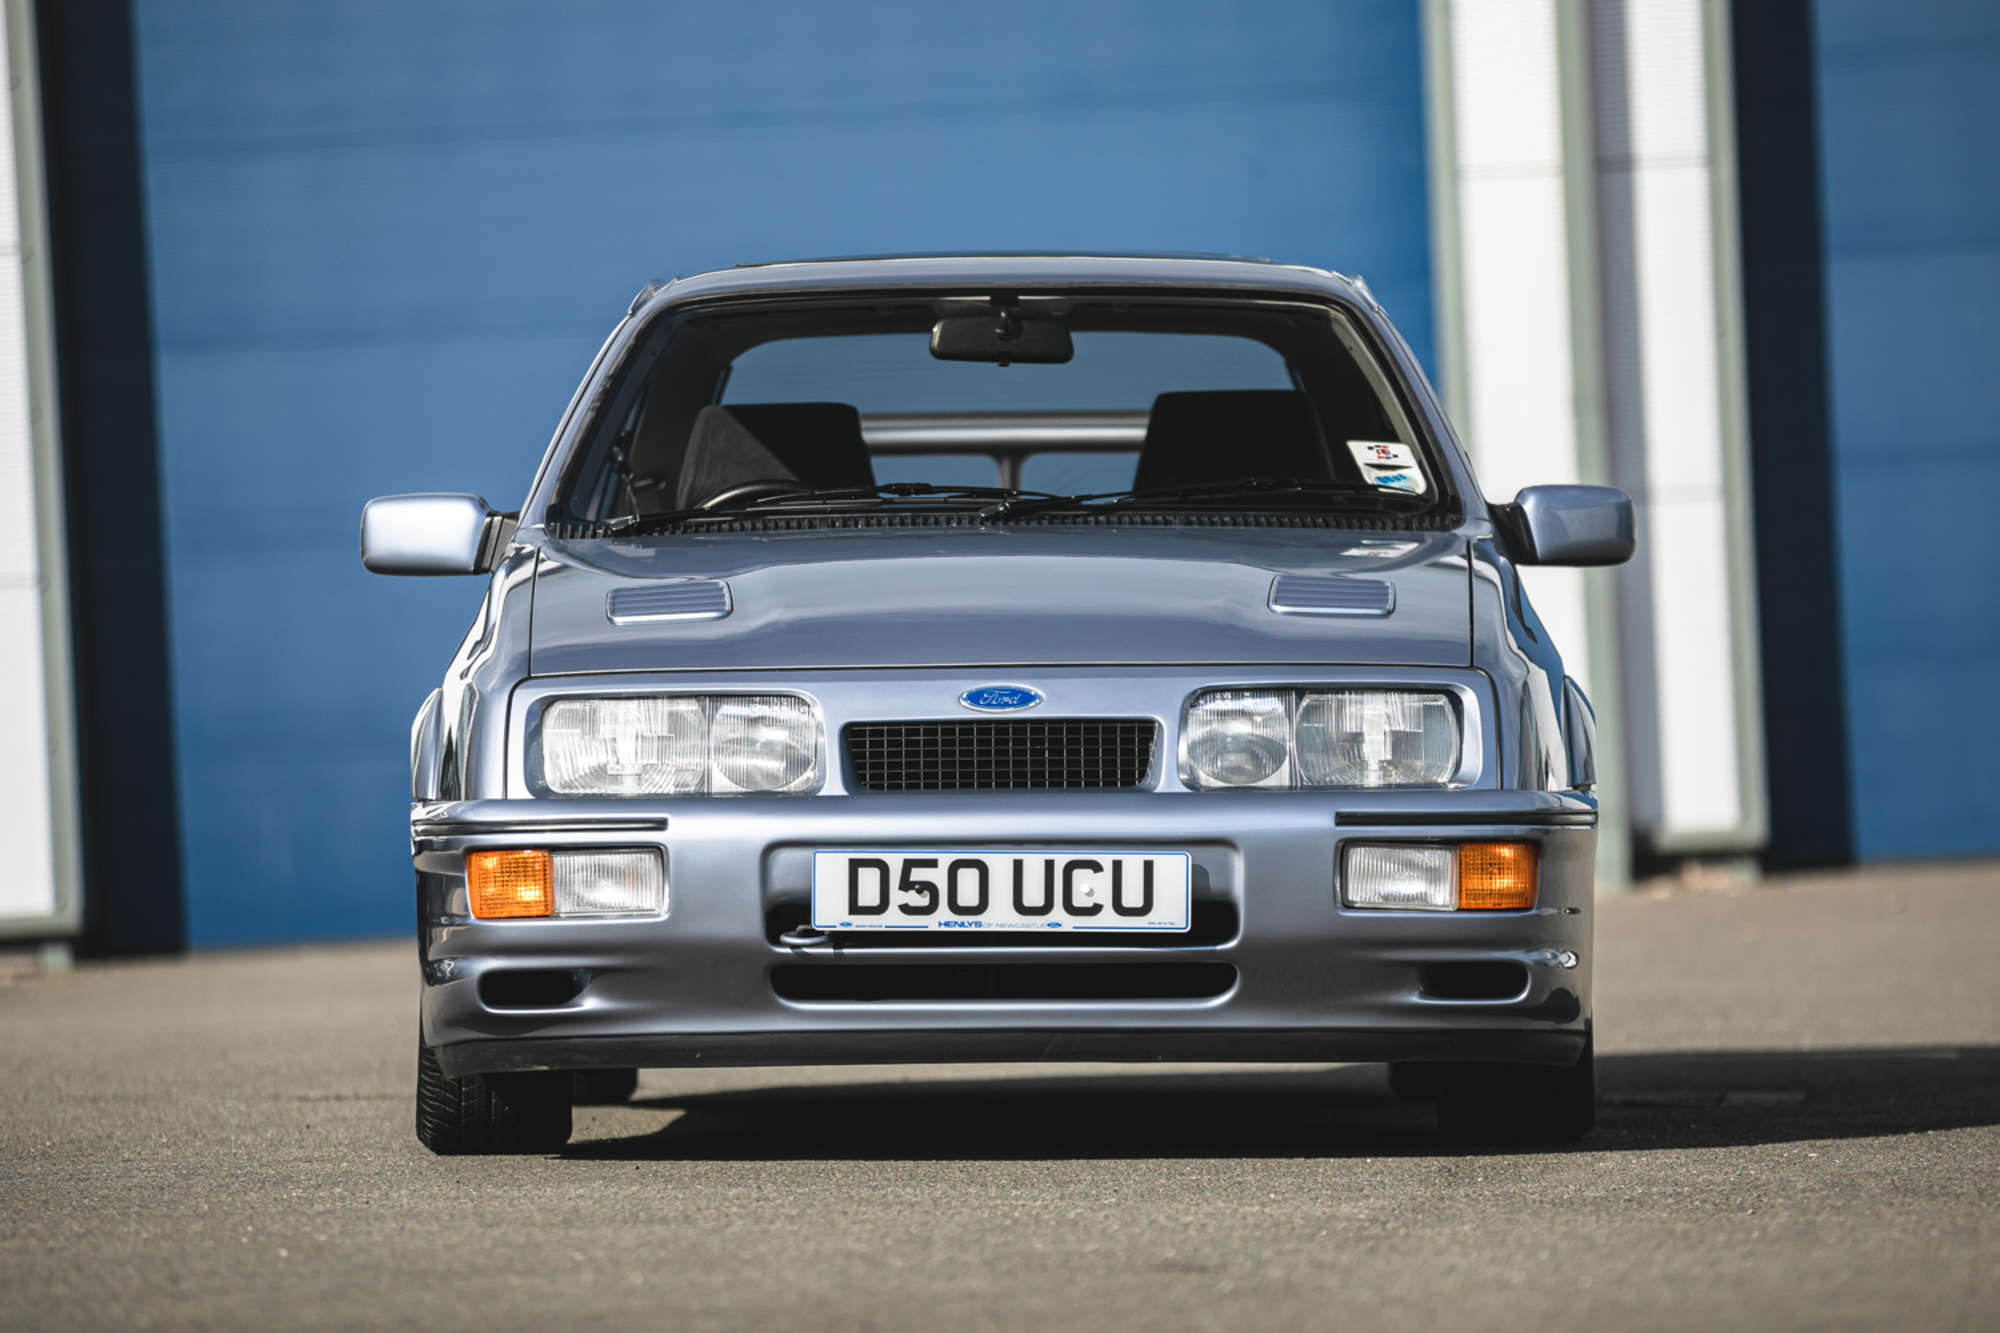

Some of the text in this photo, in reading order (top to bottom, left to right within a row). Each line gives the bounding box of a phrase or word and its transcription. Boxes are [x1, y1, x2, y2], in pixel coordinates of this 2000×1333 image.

[980, 689, 1022, 705] Ford
[848, 858, 1154, 917] D50 UCU
[938, 920, 982, 928] HENLYS
